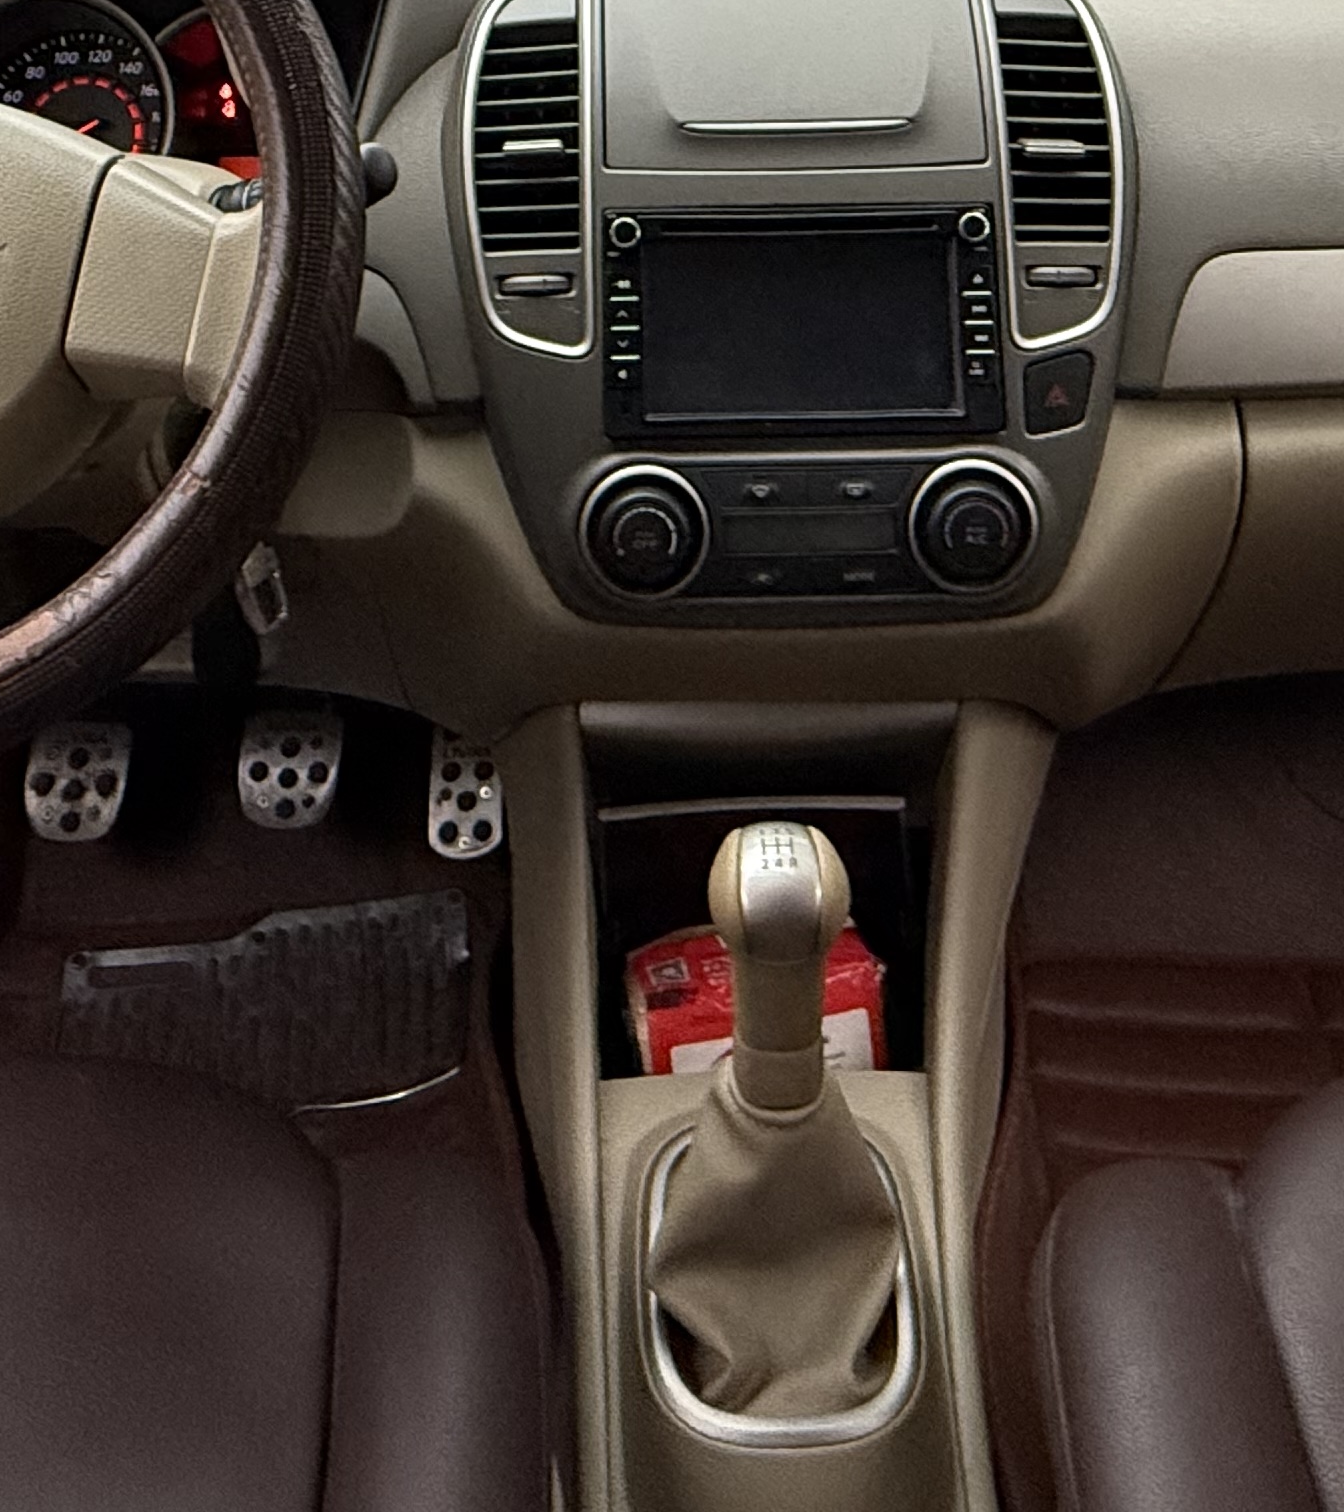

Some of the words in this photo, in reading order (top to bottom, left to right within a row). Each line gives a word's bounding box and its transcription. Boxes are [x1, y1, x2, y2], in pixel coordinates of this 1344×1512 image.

[54, 51, 80, 65] 100
[88, 49, 113, 63] 120
[25, 66, 46, 79] 80
[119, 61, 143, 75] 140
[3, 89, 25, 103] 60
